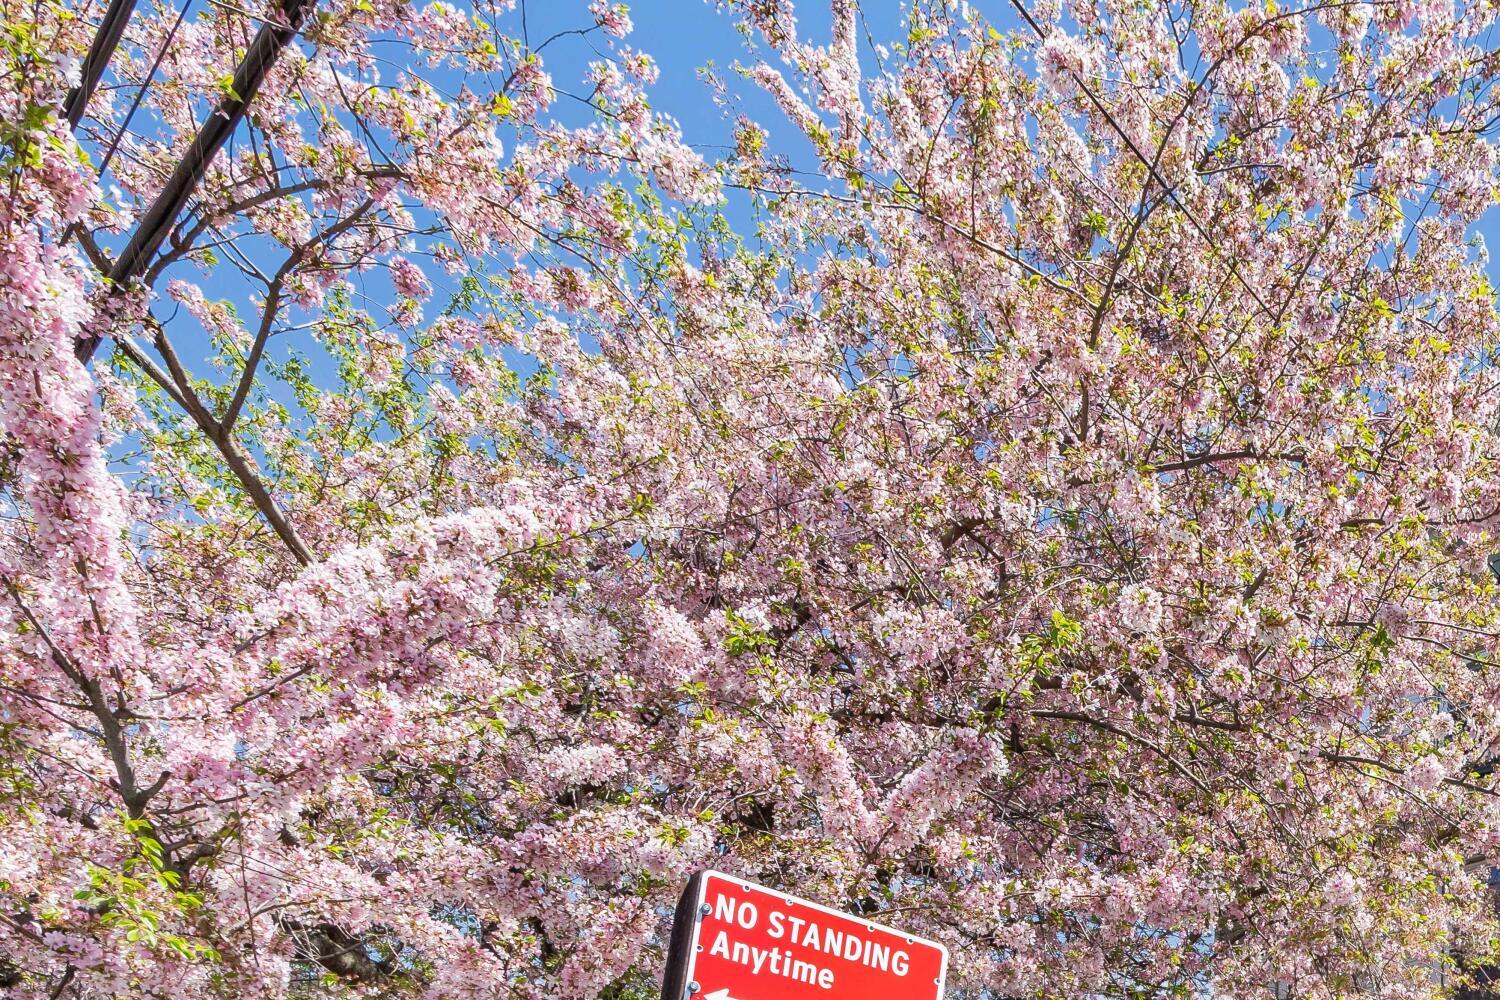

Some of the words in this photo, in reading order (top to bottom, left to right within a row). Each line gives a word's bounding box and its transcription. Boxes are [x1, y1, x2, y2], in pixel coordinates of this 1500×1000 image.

[709, 930, 835, 989] Anytime
[714, 893, 758, 930] NO
[767, 911, 910, 977] STANDING
